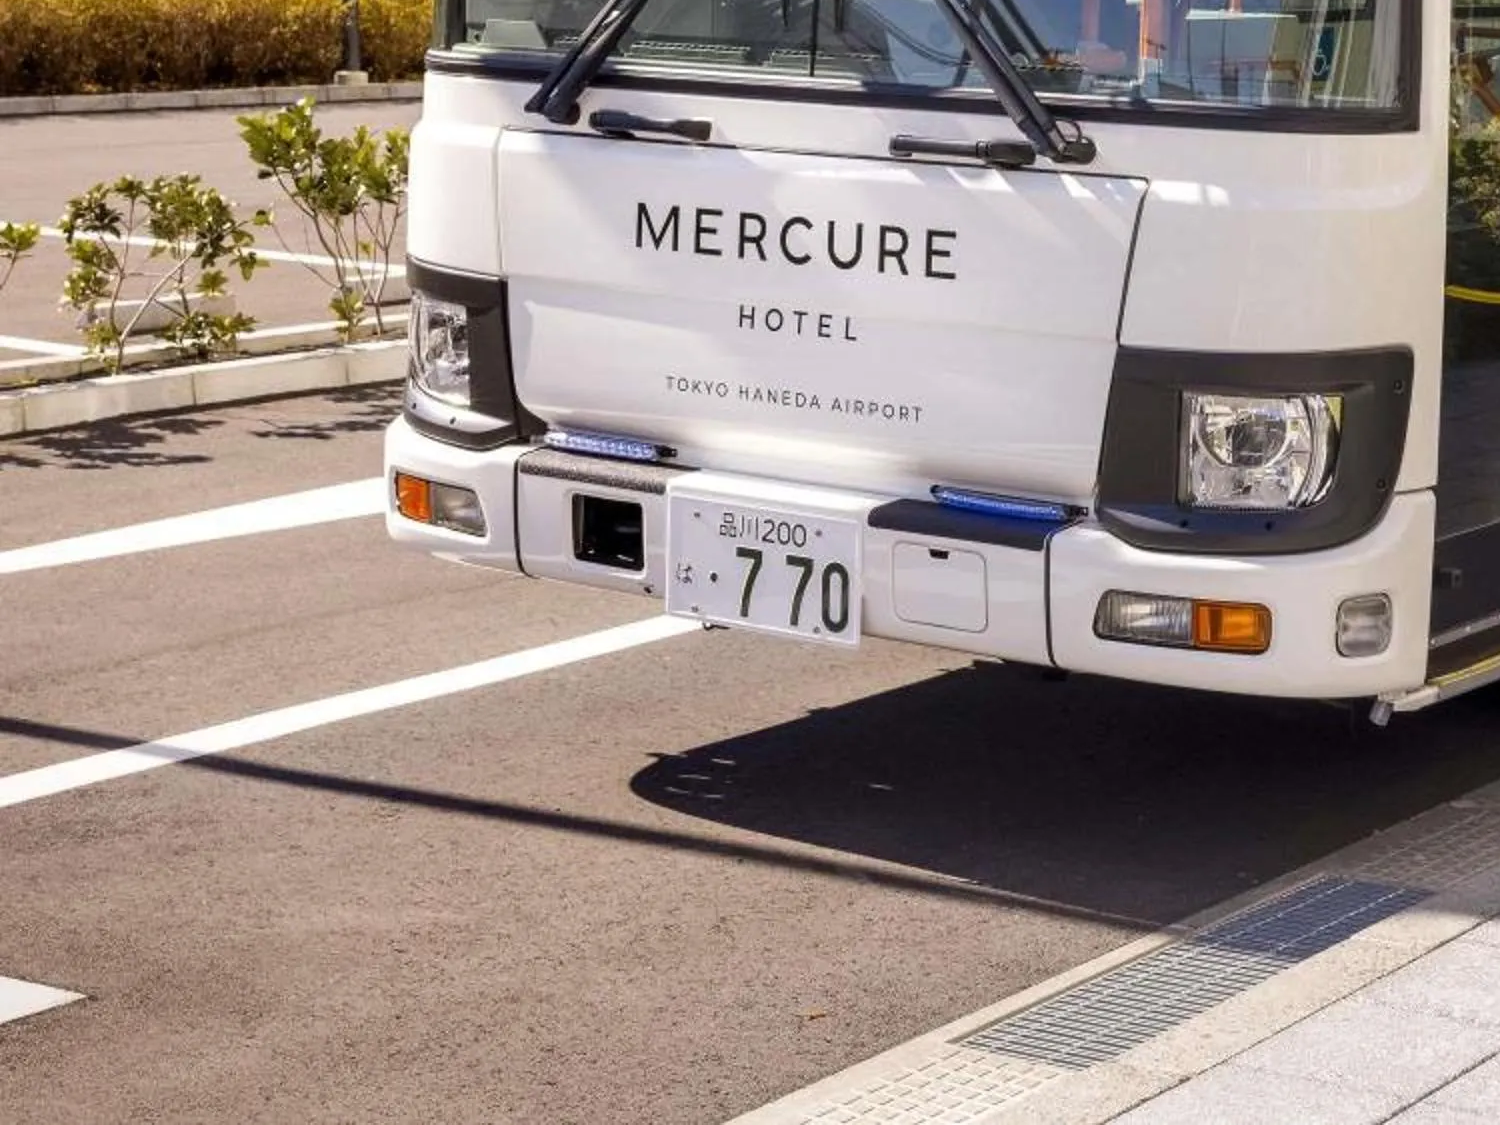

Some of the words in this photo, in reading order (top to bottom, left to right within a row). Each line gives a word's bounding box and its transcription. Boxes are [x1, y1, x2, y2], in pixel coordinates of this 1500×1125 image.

[635, 202, 957, 280] MERCURE
[738, 305, 859, 342] HOTEL
[665, 375, 730, 399] TOKYO
[737, 385, 823, 411] HANEDA
[829, 395, 924, 424] AIRPORT
